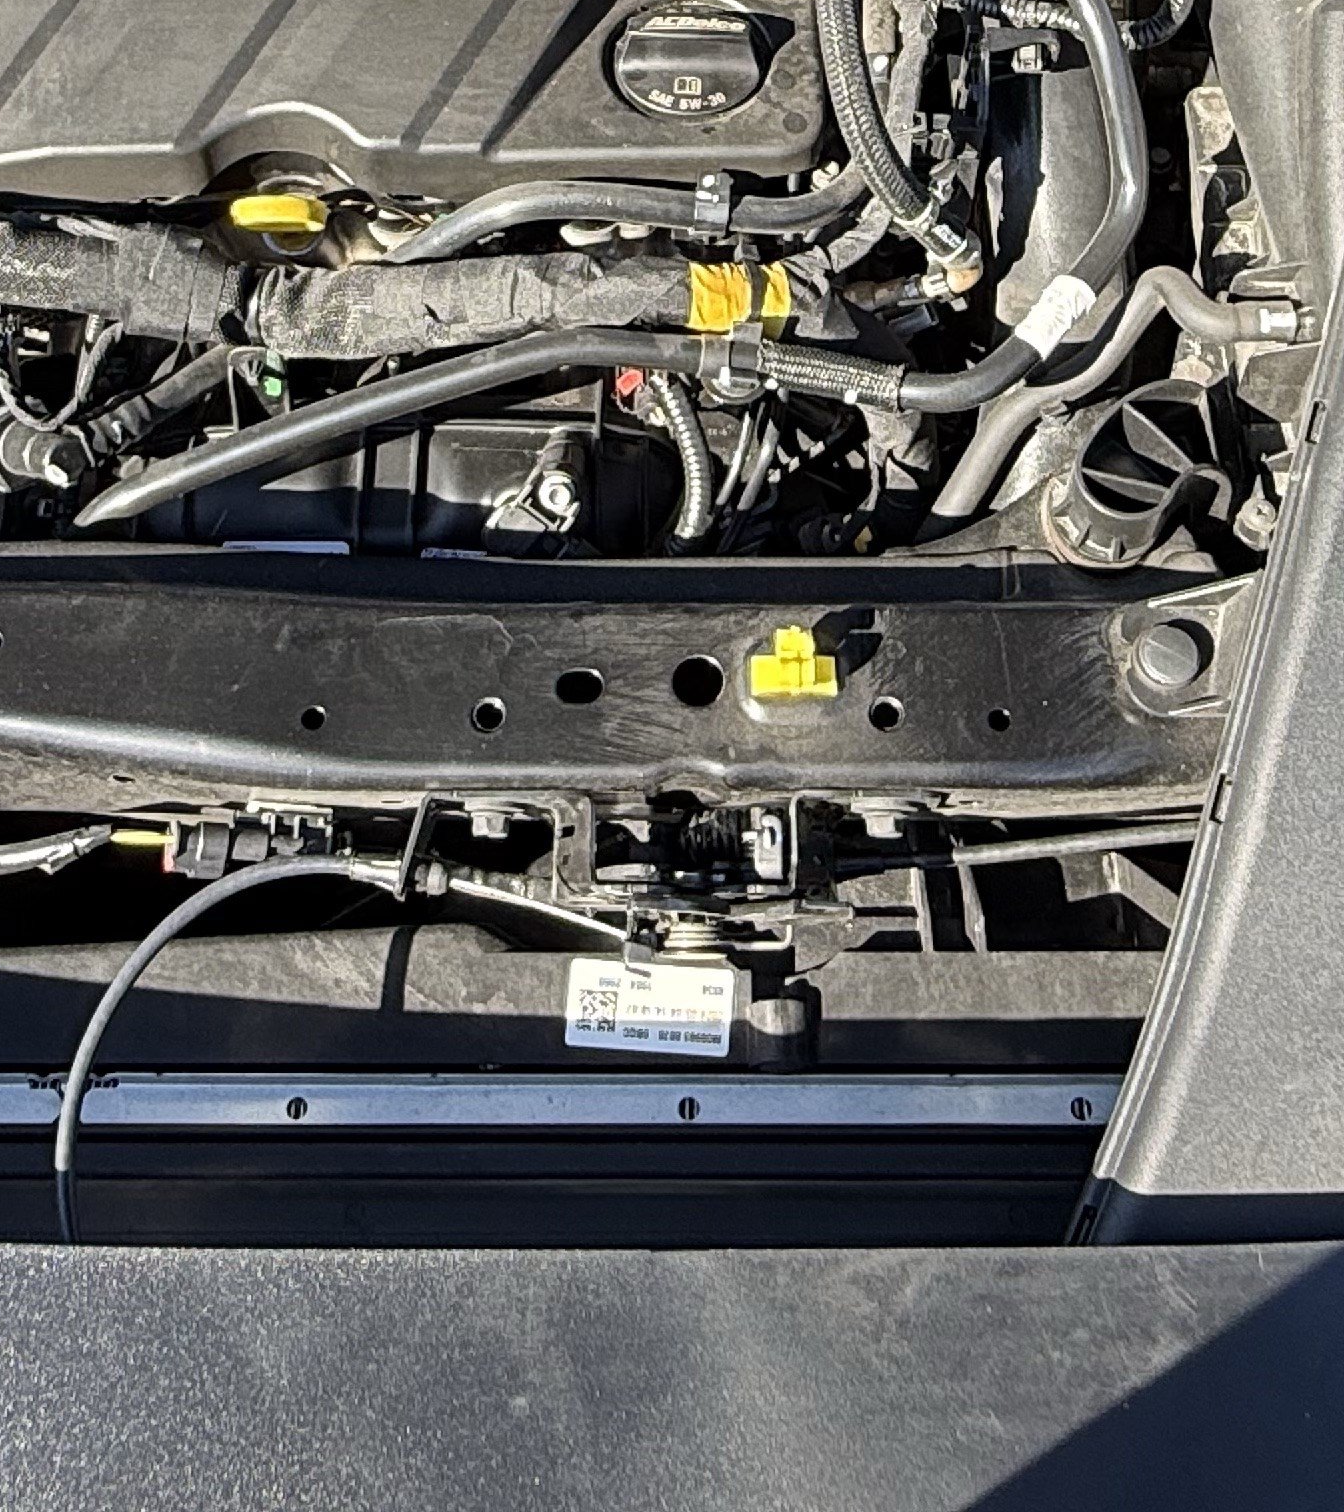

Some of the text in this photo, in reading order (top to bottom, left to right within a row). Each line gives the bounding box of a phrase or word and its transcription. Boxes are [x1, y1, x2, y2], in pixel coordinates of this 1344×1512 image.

[642, 16, 746, 33] ACDelco
[648, 89, 726, 109] SAE 5W-30
